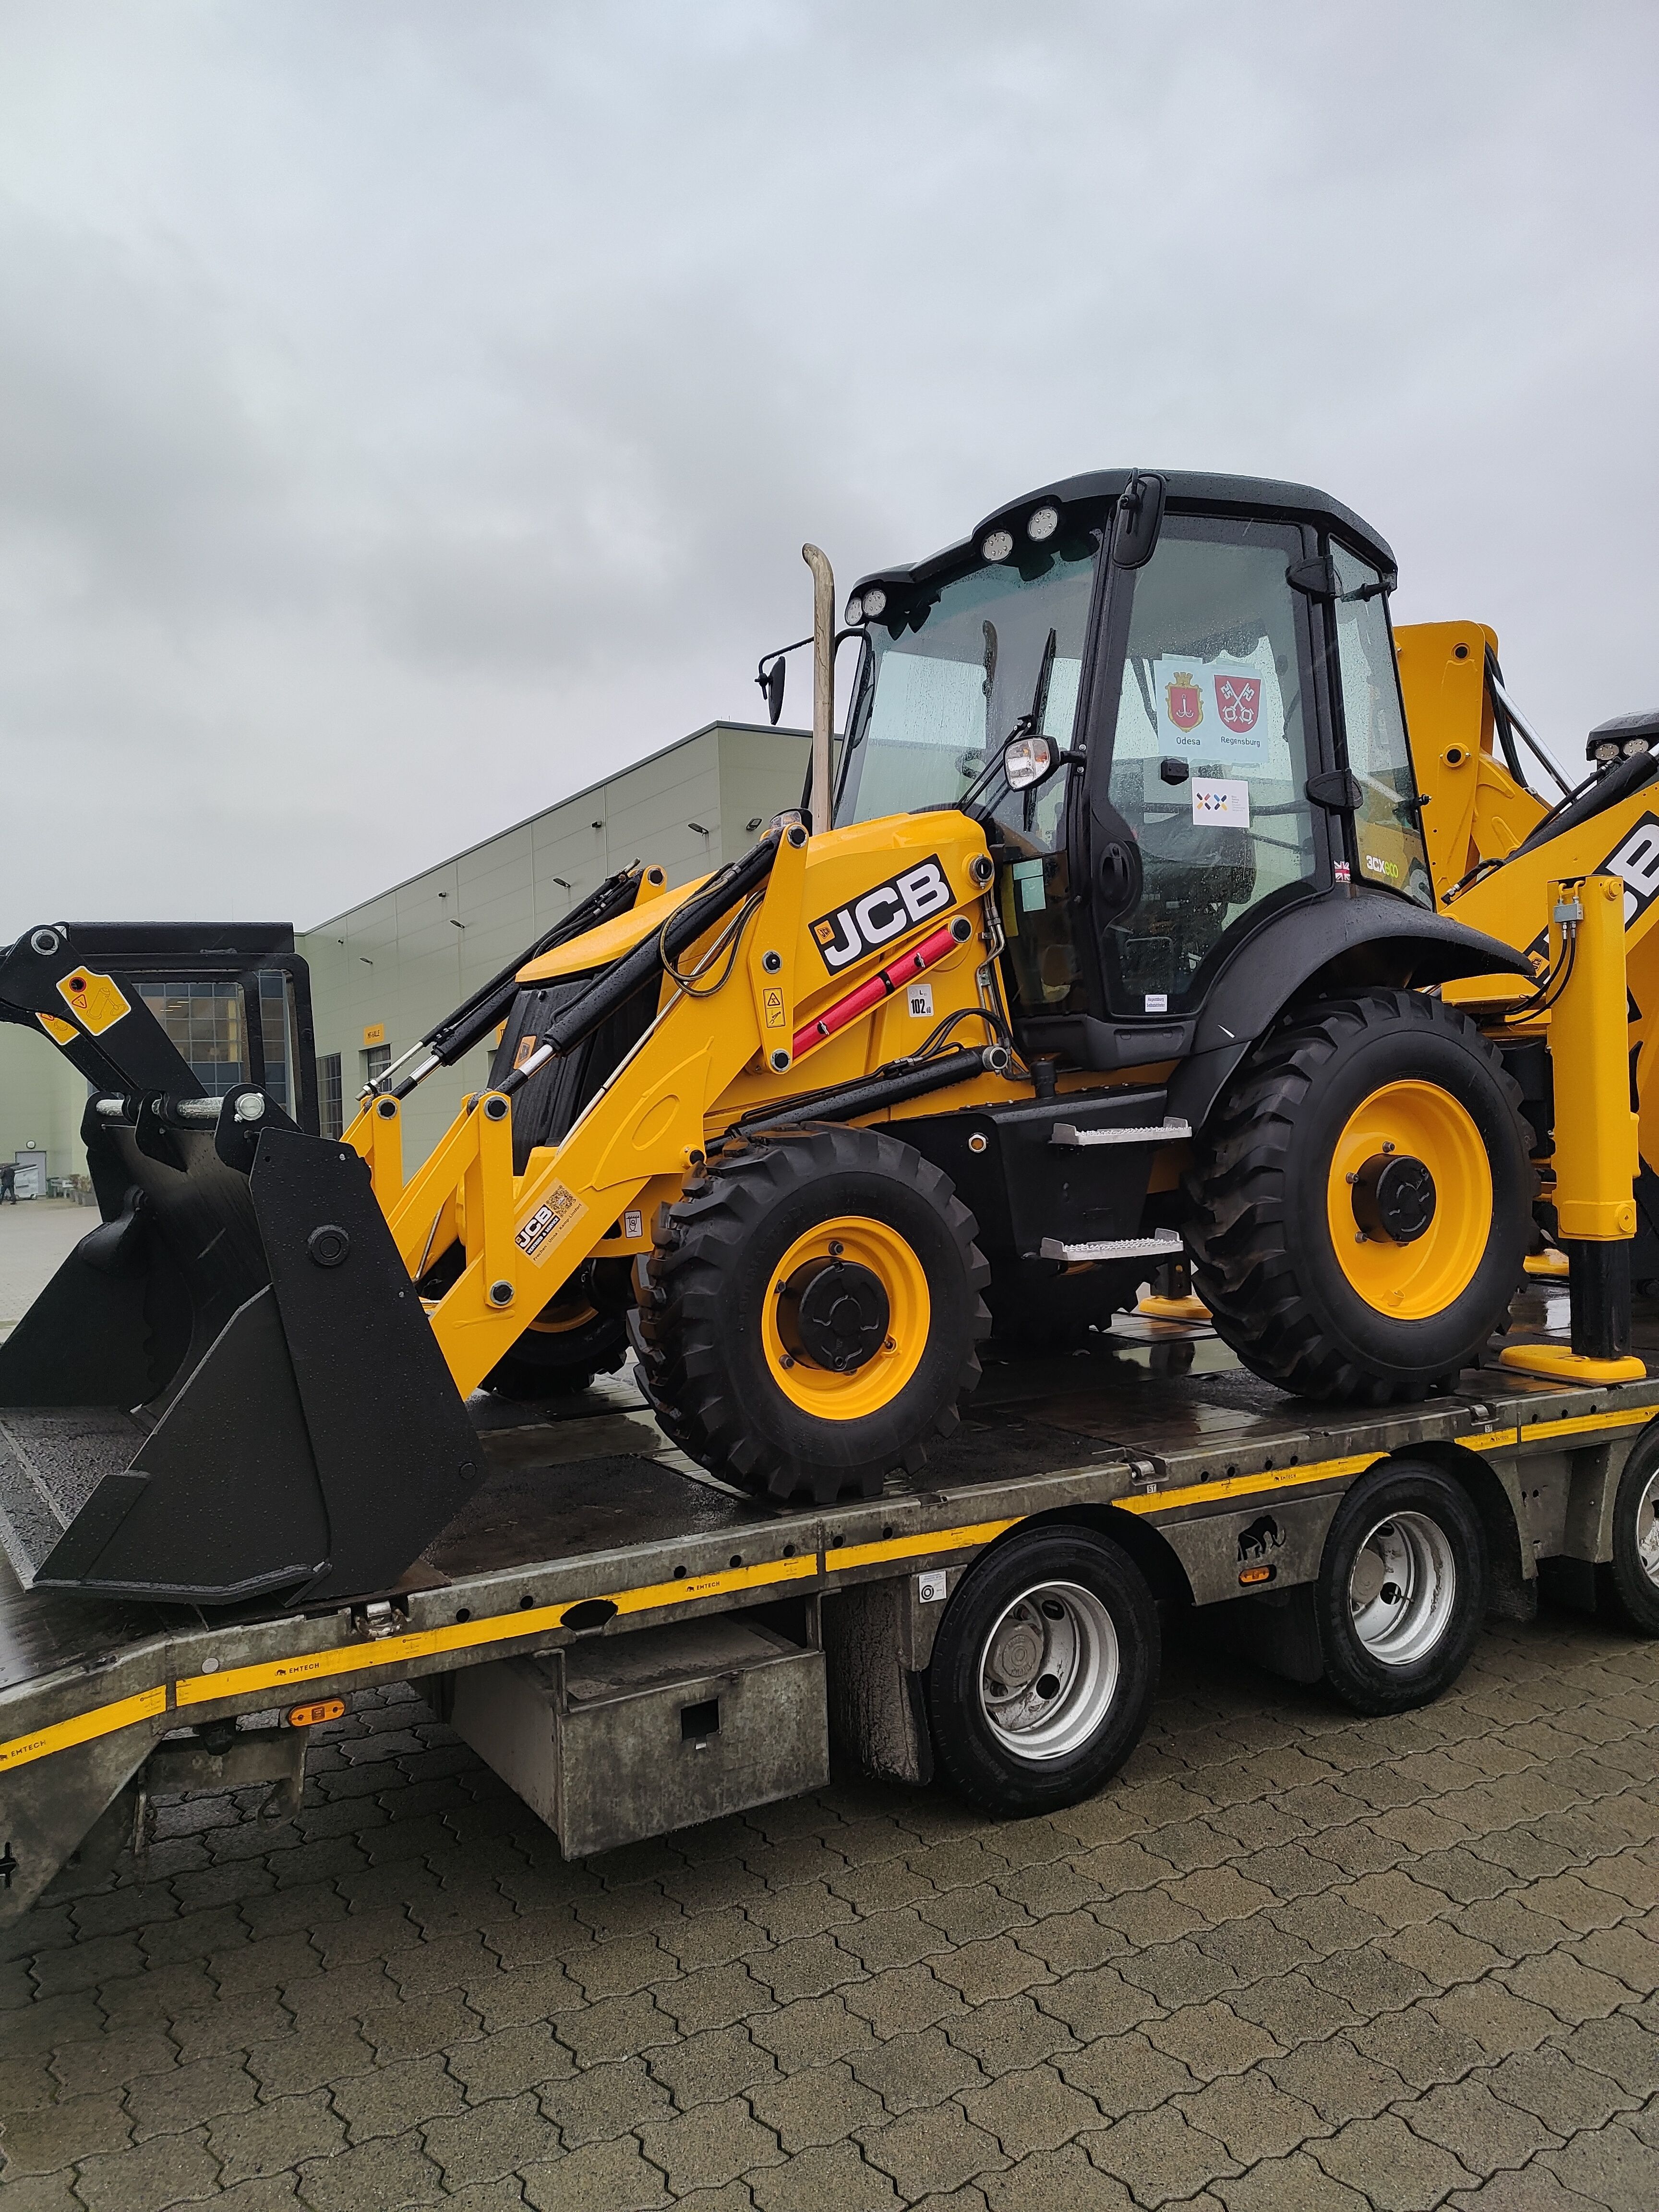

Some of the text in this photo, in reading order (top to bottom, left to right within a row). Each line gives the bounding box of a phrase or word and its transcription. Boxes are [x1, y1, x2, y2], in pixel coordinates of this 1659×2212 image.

[1176, 736, 1261, 748] Odesa Regensburg
[1366, 854, 1399, 878] 3CXeco
[824, 863, 950, 966] JCB
[819, 927, 830, 938] JCB
[911, 998, 926, 1014] 102
[519, 1206, 553, 1248] JCB
[527, 1235, 543, 1254] VERTRIEB
[545, 1217, 559, 1233] SERVICE
[533, 1203, 582, 1261] Frechen Unna Kamp-Lintfort
[697, 1581, 720, 1590] EMTECH
[289, 1662, 319, 1673] EMTECH
[11, 1740, 46, 1757] EMTECH
